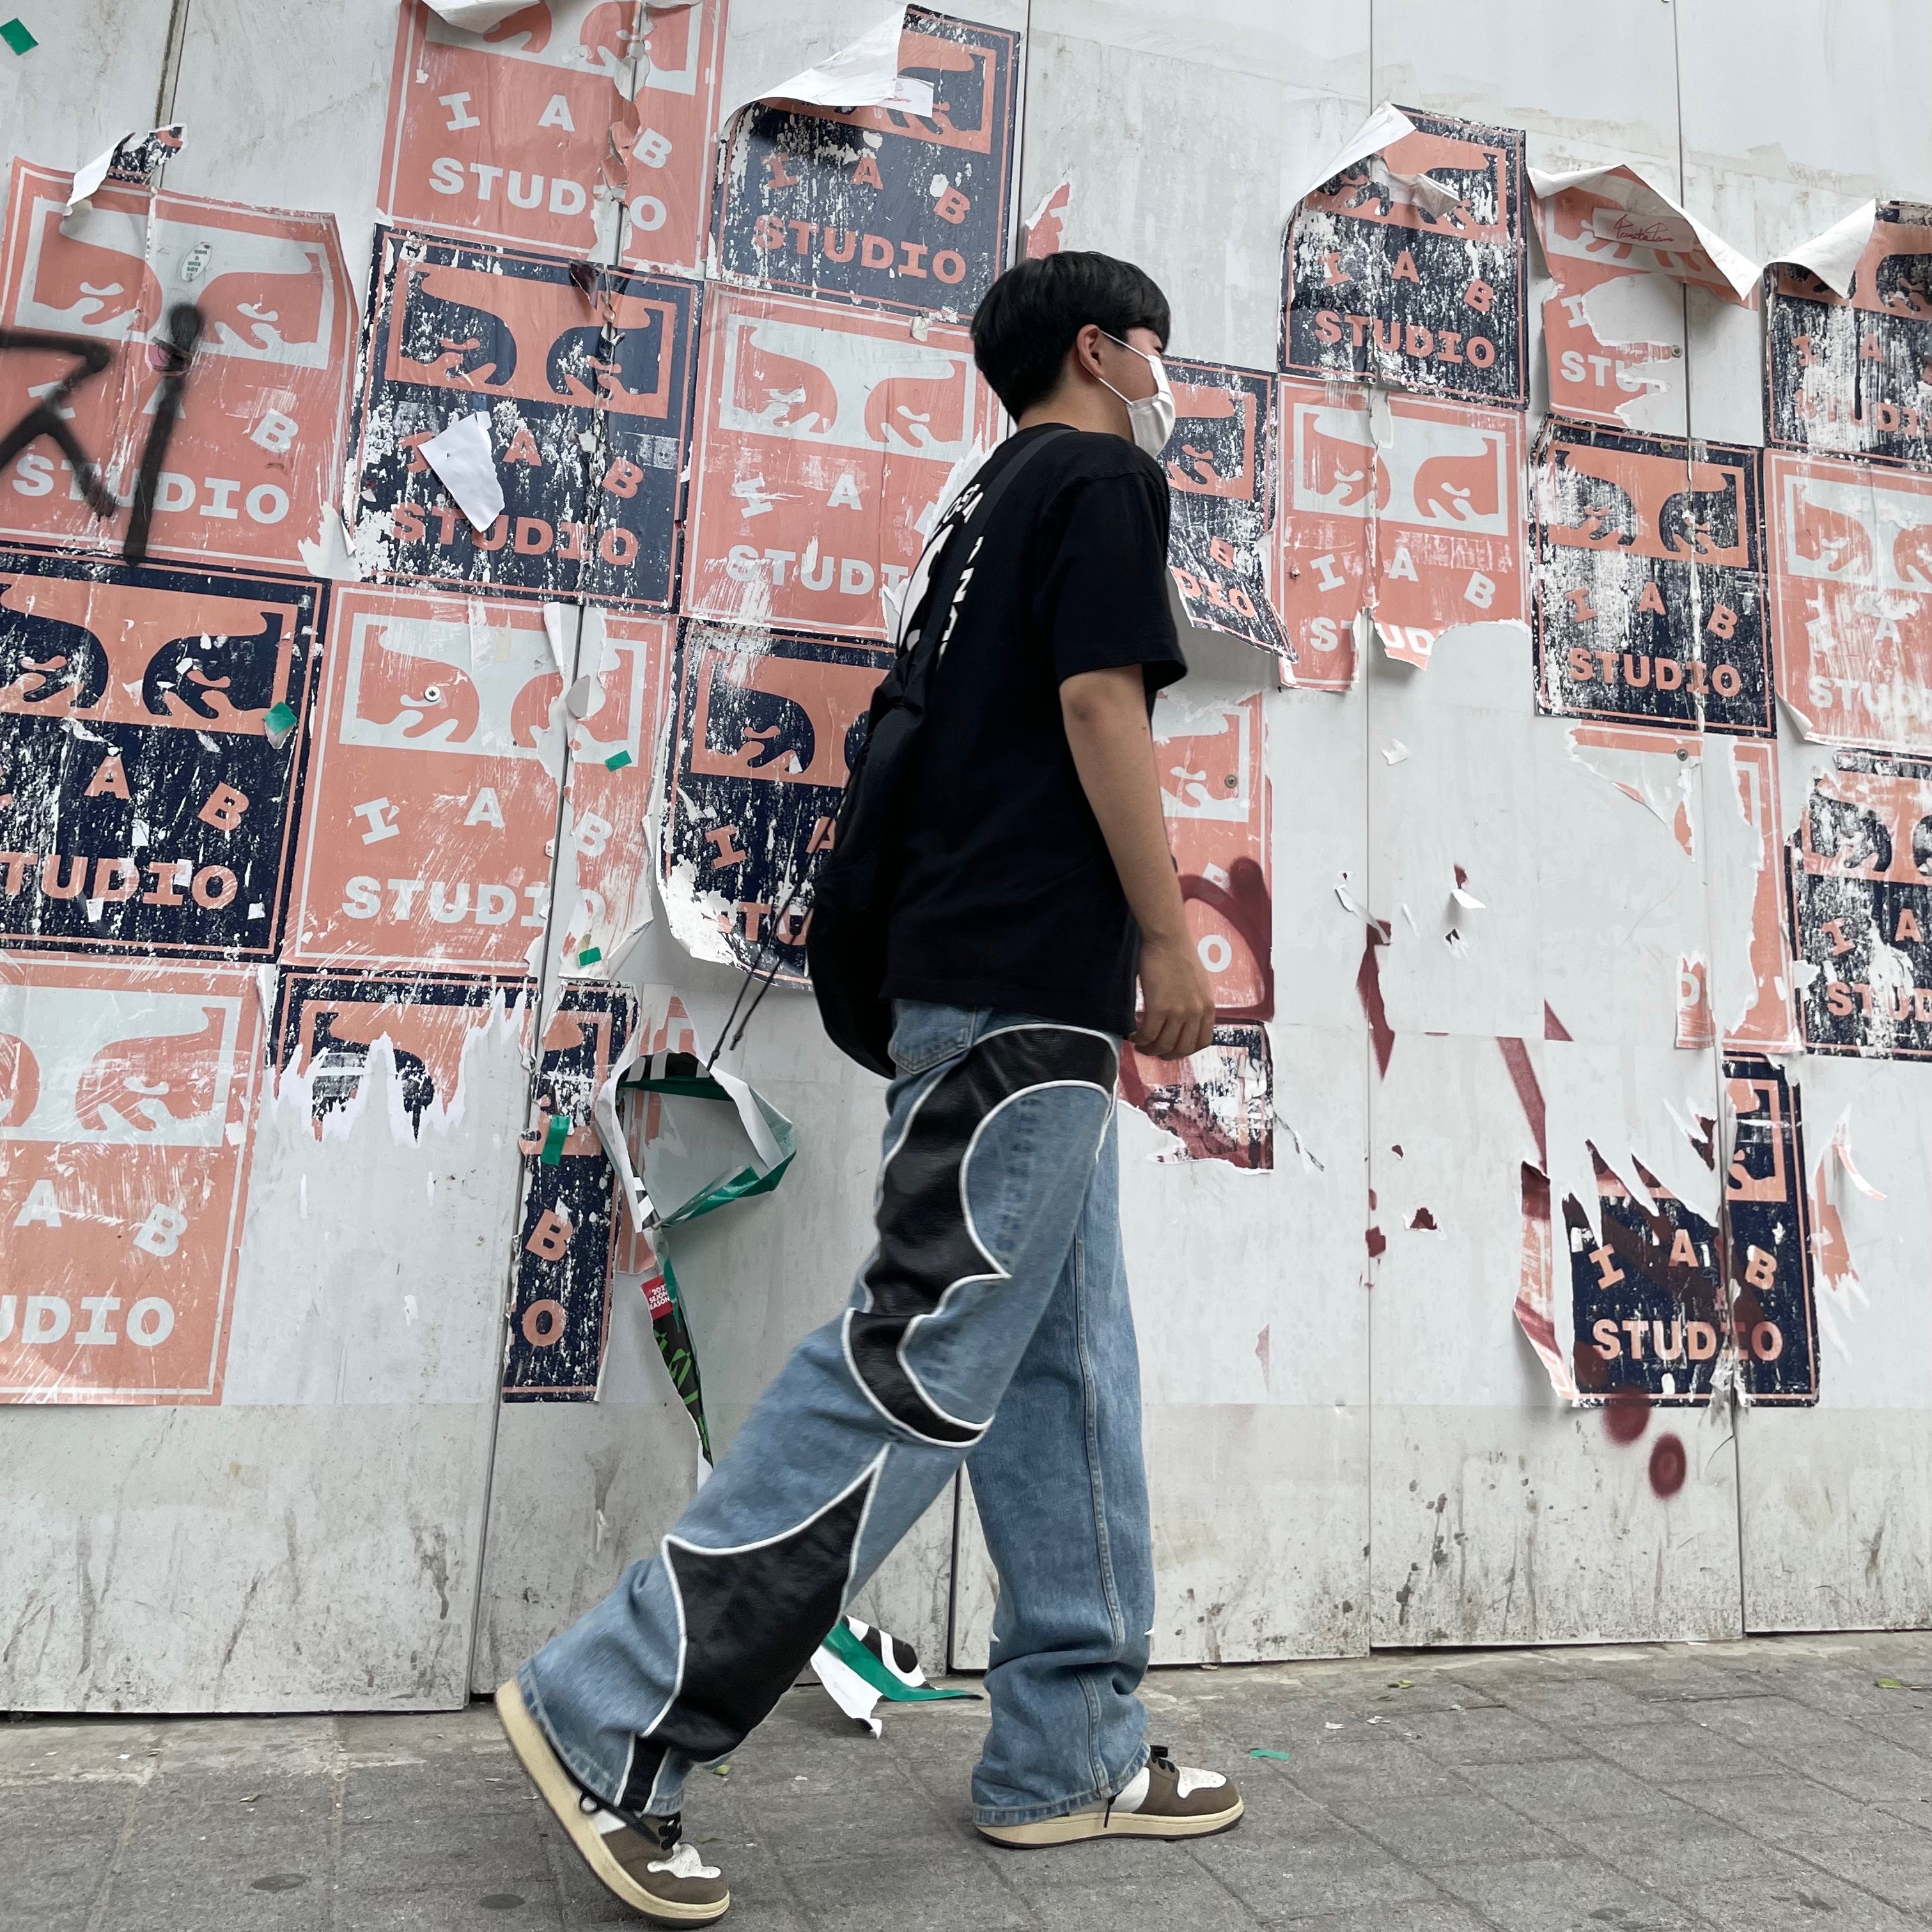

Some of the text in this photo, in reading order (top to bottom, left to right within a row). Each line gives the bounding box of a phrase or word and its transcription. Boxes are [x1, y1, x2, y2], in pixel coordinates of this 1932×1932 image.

[753, 214, 965, 284] STUDIO
[1314, 310, 1495, 368] STUDIO
[390, 502, 639, 565] STUDIO
[1568, 647, 1741, 697] STUDIO
